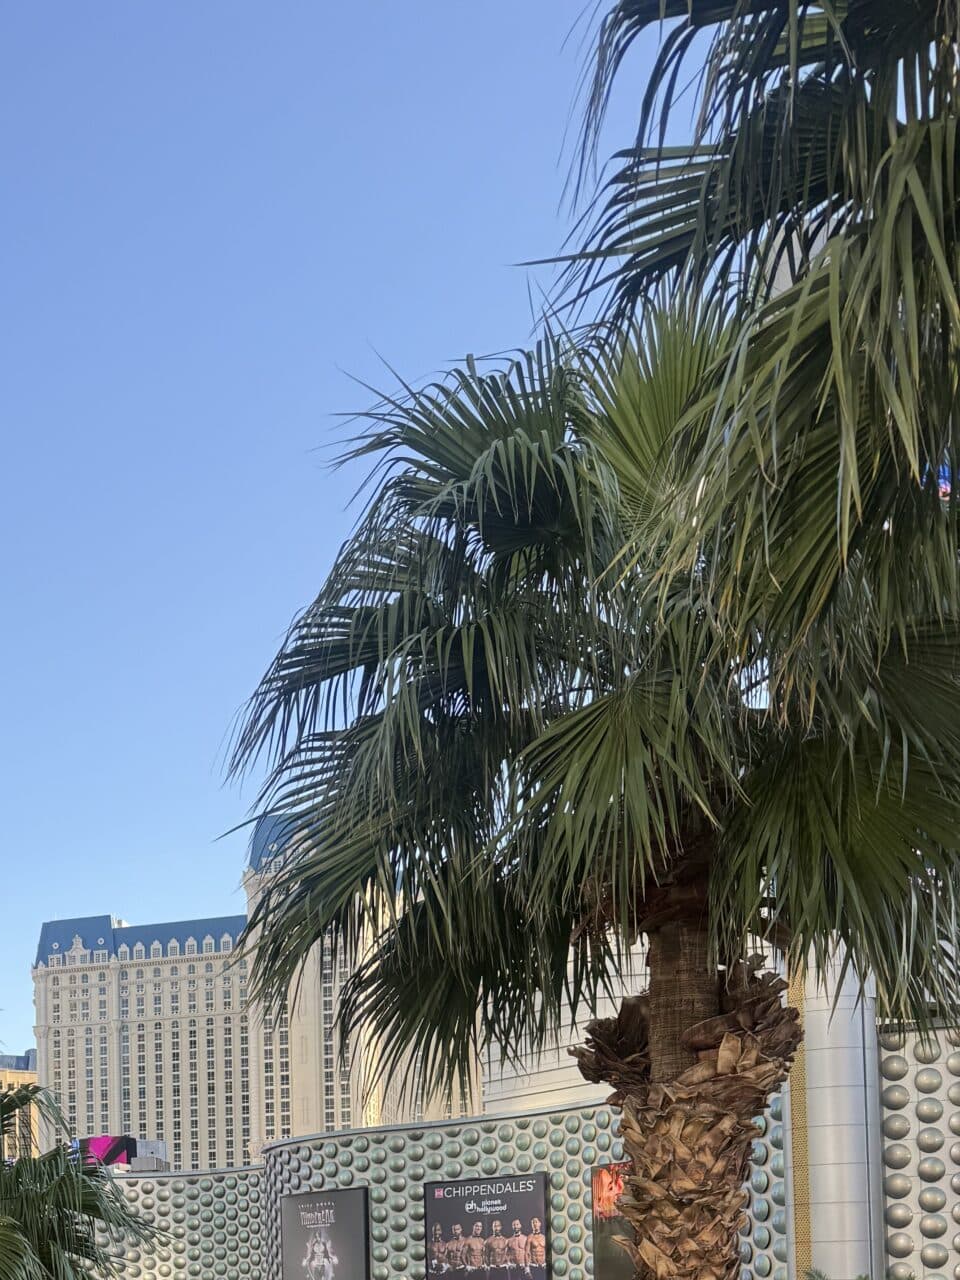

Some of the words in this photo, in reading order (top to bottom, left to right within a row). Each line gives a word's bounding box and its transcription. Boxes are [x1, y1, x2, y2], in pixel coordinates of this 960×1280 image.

[444, 1180, 535, 1198] CHIPPENDALES
[481, 1199, 501, 1208] planet
[477, 1204, 508, 1214] hollywood
